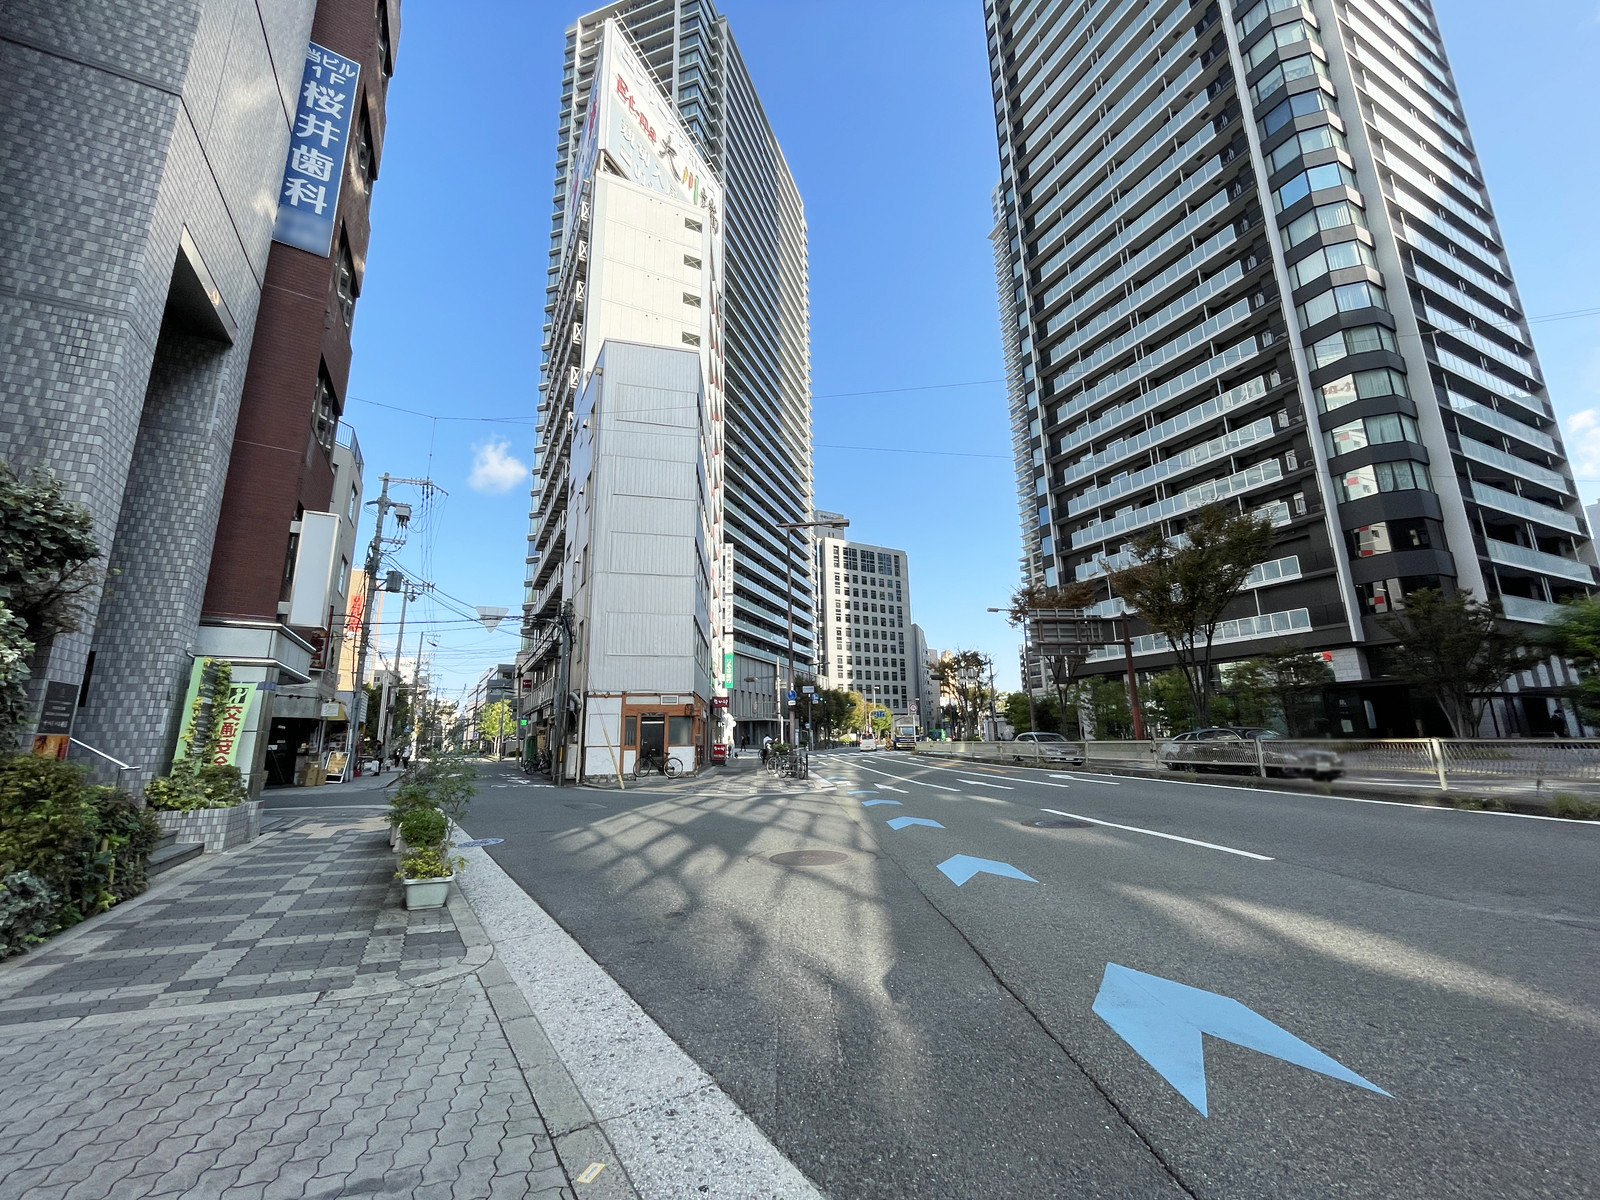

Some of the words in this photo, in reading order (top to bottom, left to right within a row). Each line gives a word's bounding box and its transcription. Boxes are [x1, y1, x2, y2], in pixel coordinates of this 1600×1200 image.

[305, 48, 356, 78] 当ビル
[284, 80, 346, 215] 桜井歯科
